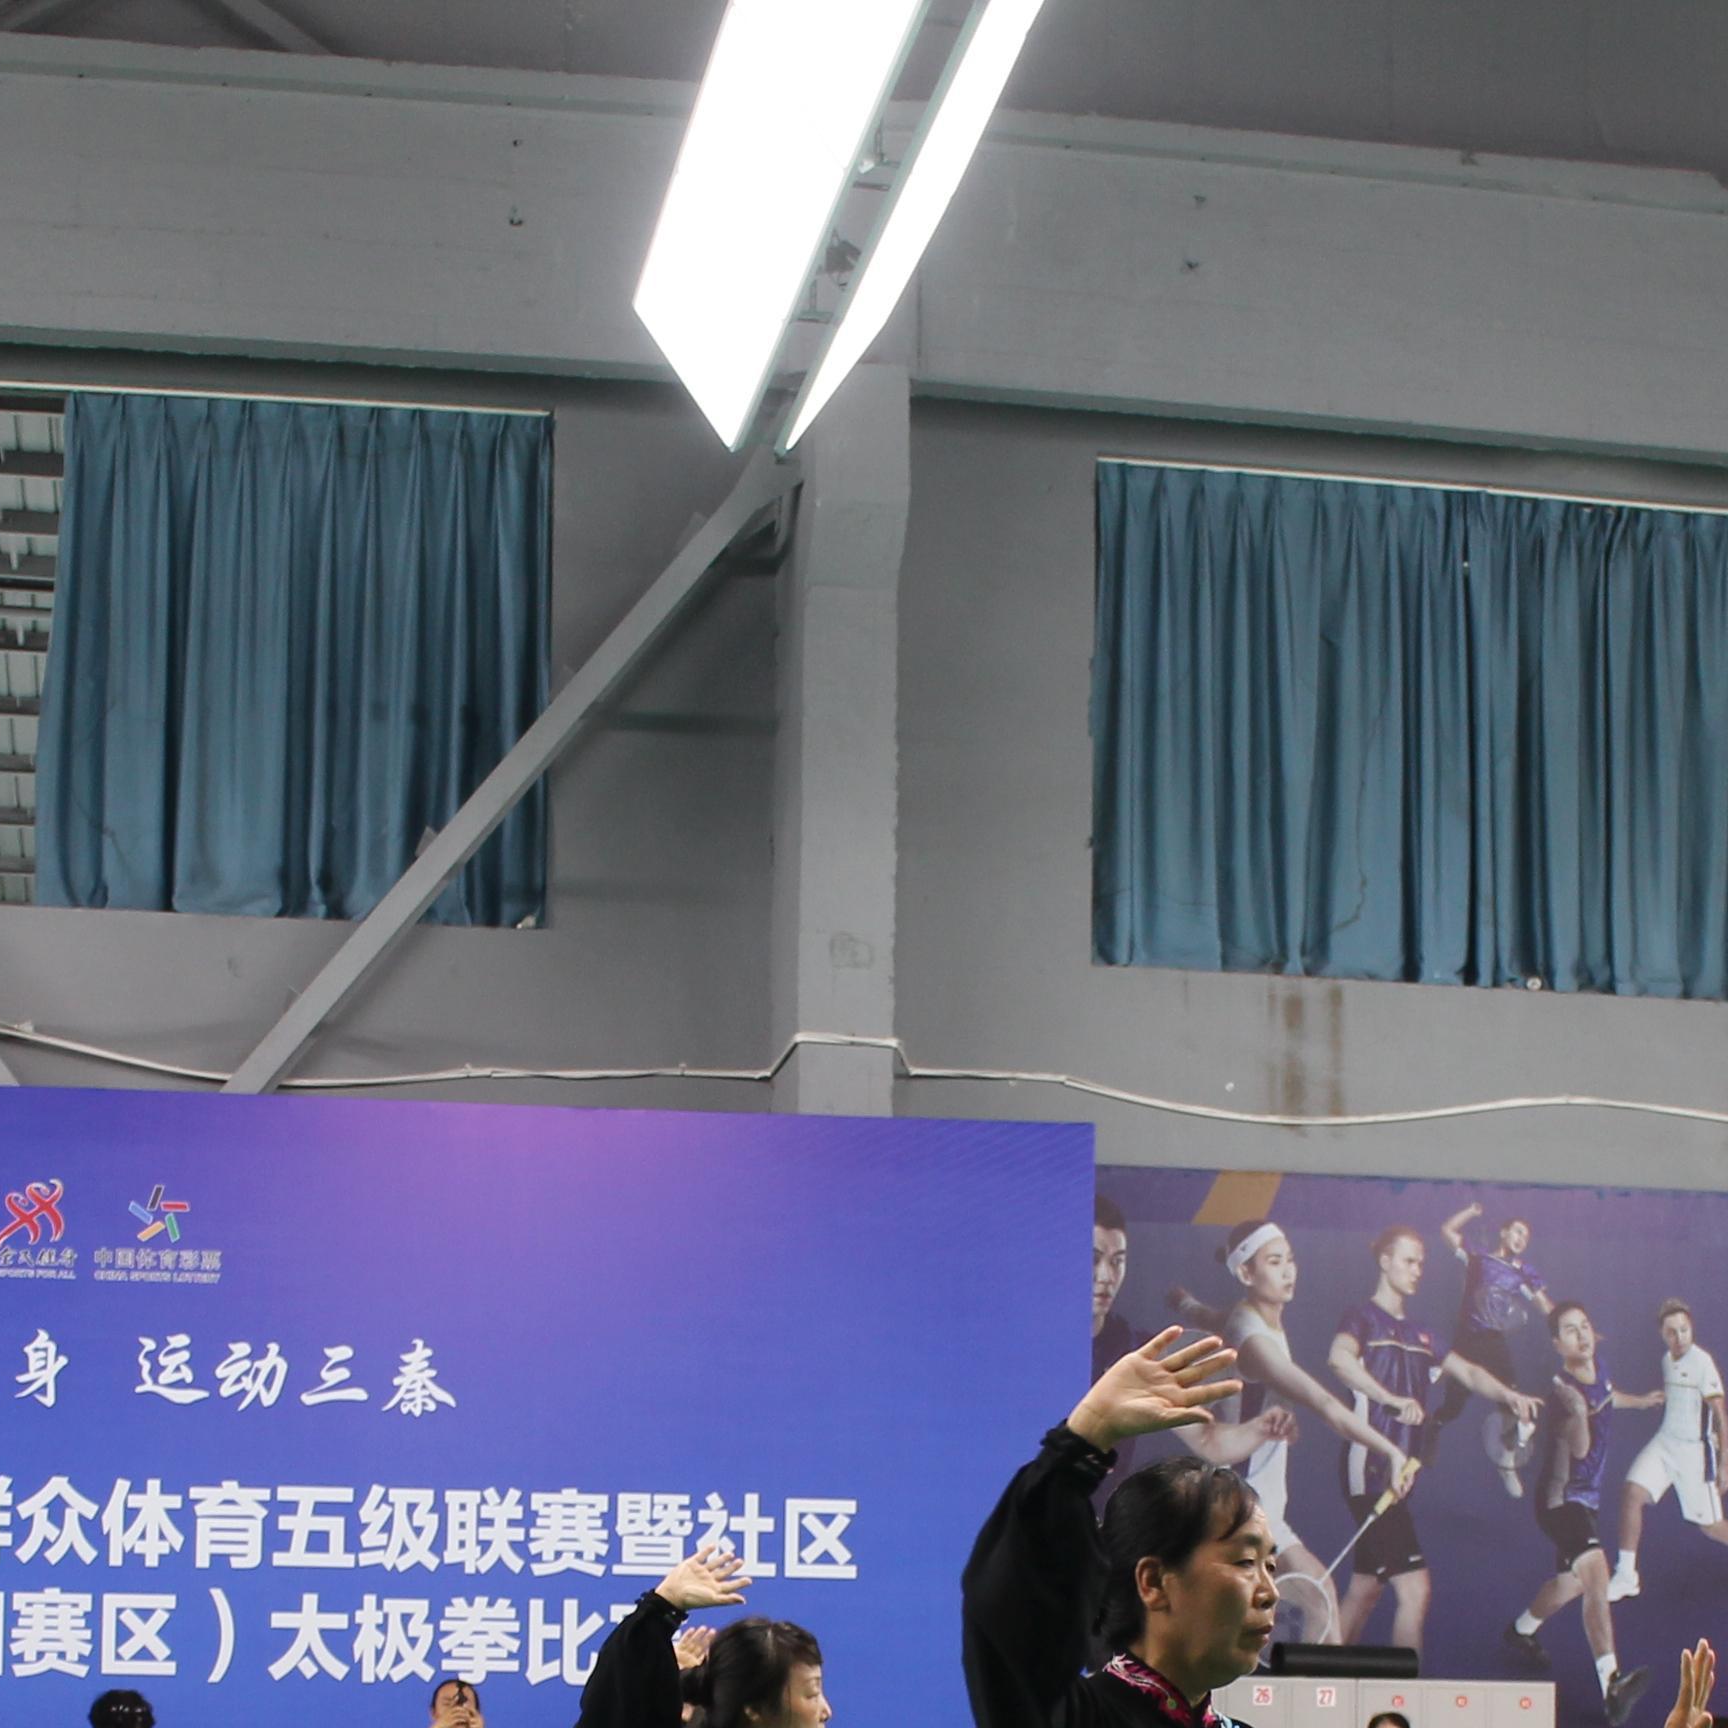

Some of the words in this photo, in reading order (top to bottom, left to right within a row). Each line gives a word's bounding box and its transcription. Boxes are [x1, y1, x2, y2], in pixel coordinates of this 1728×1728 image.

[93, 1246, 223, 1271] 中国体育彩票
[134, 1332, 458, 1419] 运动三秦
